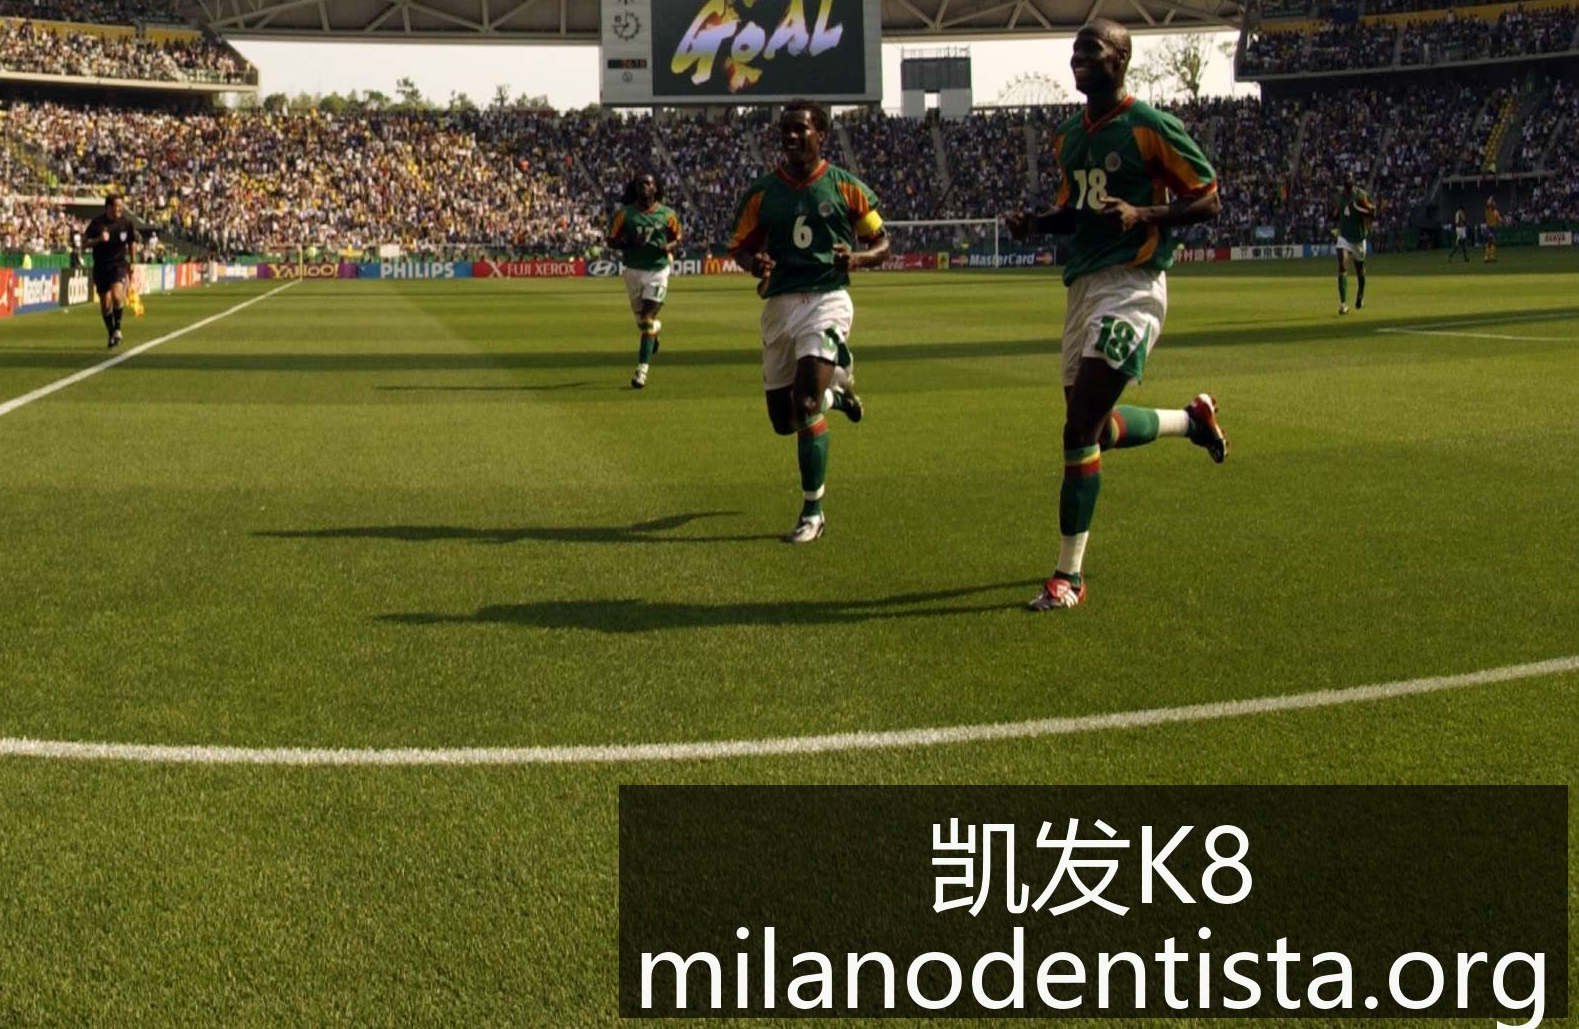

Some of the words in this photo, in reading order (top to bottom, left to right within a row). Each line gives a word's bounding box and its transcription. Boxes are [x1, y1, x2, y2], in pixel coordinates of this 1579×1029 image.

[1073, 169, 1107, 211] 18
[793, 215, 813, 249] 6
[269, 263, 339, 278] YAHOO!
[380, 262, 454, 278] PHILIPS
[507, 262, 531, 275] FUJI
[535, 261, 576, 275] XEROX
[1095, 315, 1136, 362] 18
